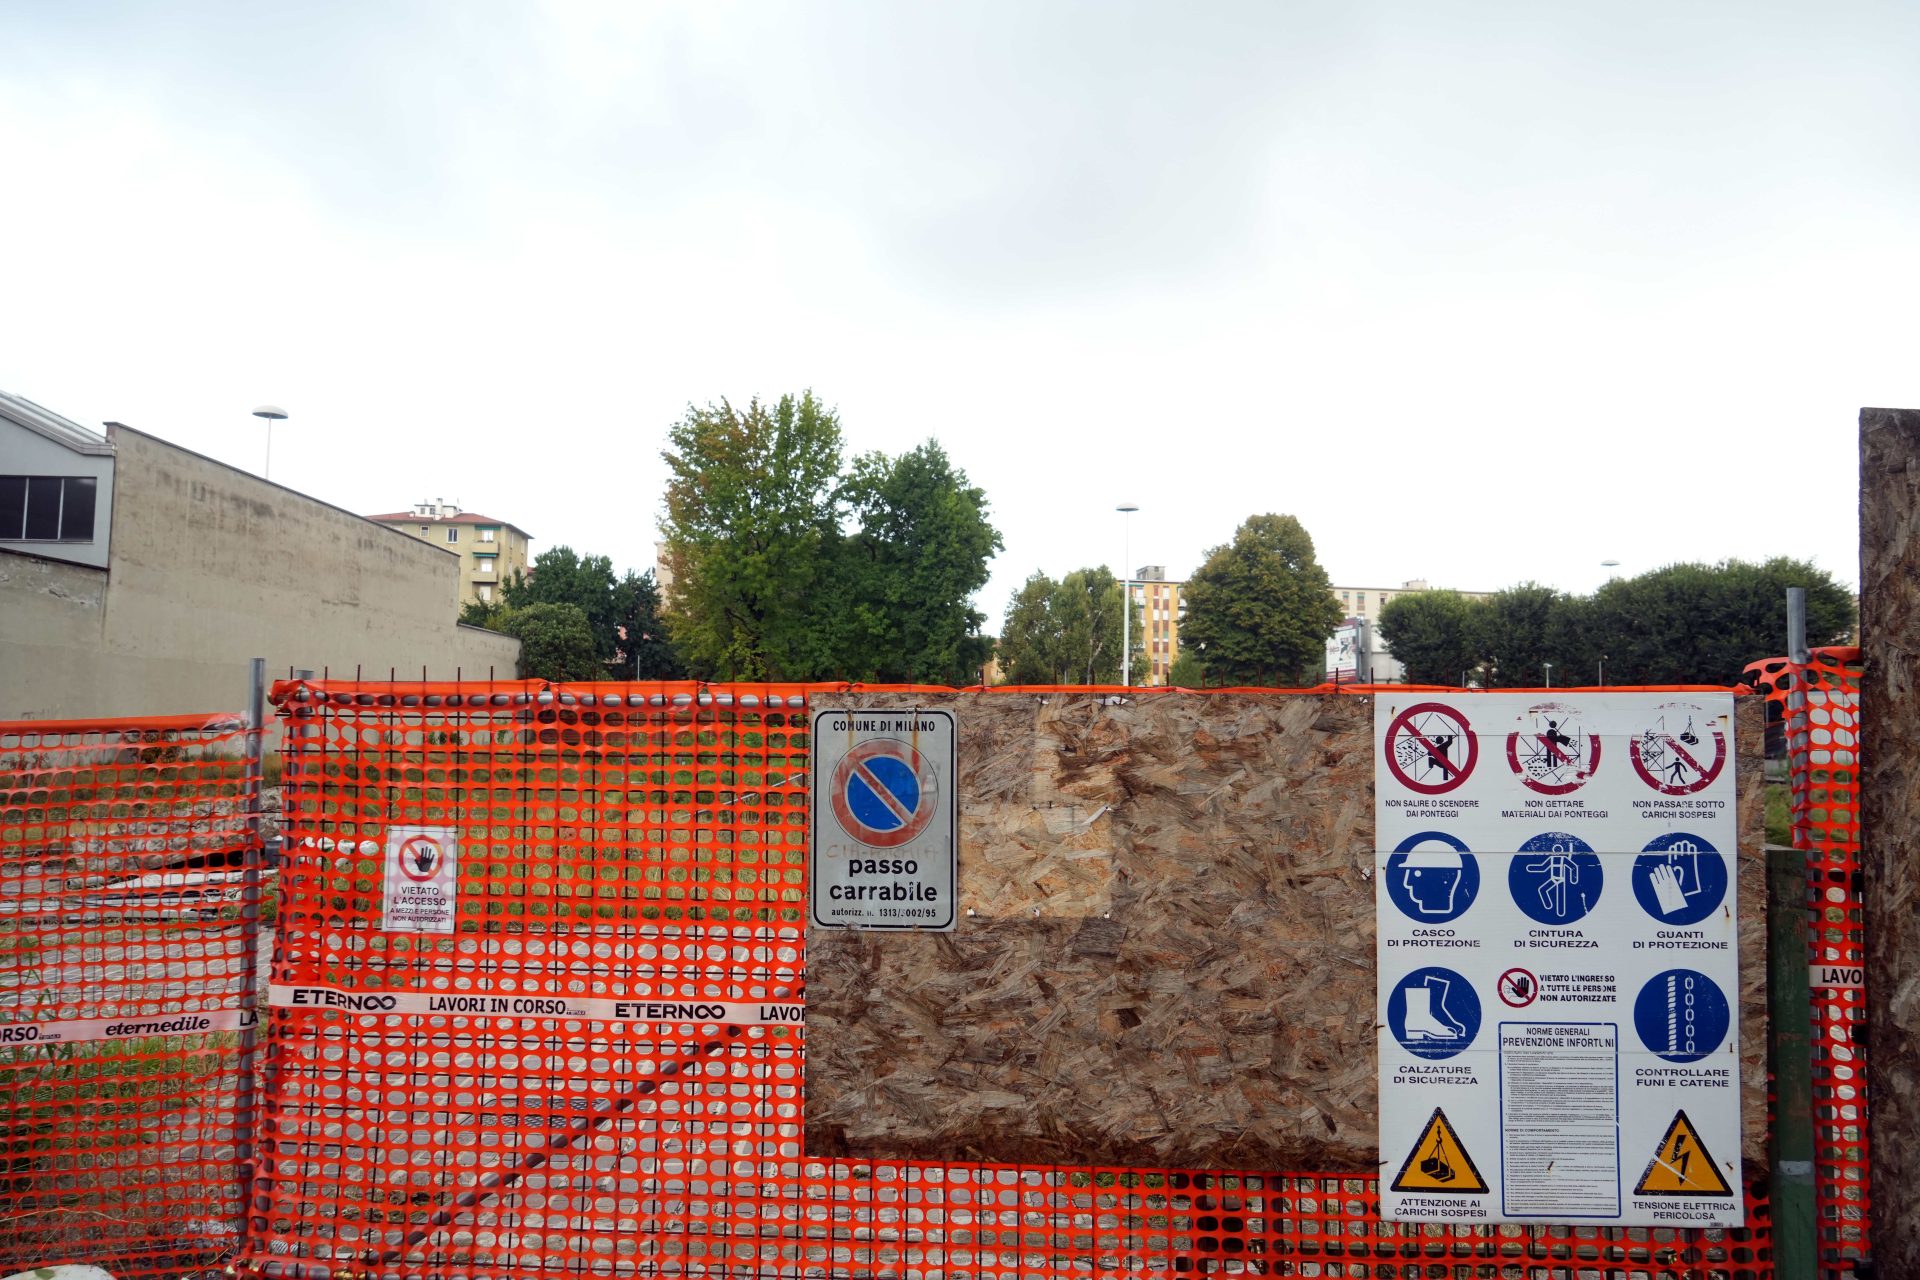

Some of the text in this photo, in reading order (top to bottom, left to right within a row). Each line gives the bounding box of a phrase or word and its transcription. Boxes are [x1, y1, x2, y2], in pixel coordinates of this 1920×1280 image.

[832, 720, 936, 732] COMUNE DI MILANO
[1402, 800, 1430, 808] SALIRE
[1431, 800, 1438, 808] O
[1438, 800, 1480, 808] SCENDERE
[1632, 800, 1653, 808] NON
[1697, 801, 1725, 809] SOTTO
[1406, 810, 1460, 818] DAI PONTEGGI
[1564, 811, 1609, 819] PONTEGGI
[1641, 811, 1716, 819] CARICHI SOSPESI
[849, 860, 917, 877] passo
[401, 887, 440, 896] VIETATO
[830, 882, 937, 901] carrabile
[393, 897, 447, 906] L'ACCESSO
[420, 908, 450, 916] PERSONE
[831, 908, 864, 917] autorizz.
[1528, 930, 1584, 938] CINTURA
[1656, 931, 1704, 939] GUANTI
[1403, 939, 1481, 948] PROTEZIONE
[1529, 940, 1599, 948] SICUREZZA
[1649, 941, 1729, 950] PROTEZIONE
[1582, 985, 1617, 993] PERSONE
[1560, 995, 1617, 1003] AUTORIZZATE
[430, 997, 485, 1012] LAVORI
[491, 999, 508, 1012] IN
[514, 999, 568, 1014] CORSO
[106, 1017, 209, 1039] eternedile
[1526, 1028, 1590, 1036] NORME GENERALI
[1502, 1038, 1564, 1047] PREVENZIONE
[1399, 1066, 1472, 1075] CALZATURE
[1635, 1069, 1730, 1077] CONTROLLARE
[1408, 1077, 1479, 1085] SICUREZZA
[1636, 1079, 1665, 1087] FUNI
[1679, 1080, 1729, 1088] CATENE
[1400, 1199, 1481, 1208] ATTENZIONE AI
[1632, 1202, 1736, 1211] TENSIONE ELETTRICA
[1394, 1208, 1487, 1218] CARICHI SOSPESI
[1653, 1212, 1716, 1220] PERICOLOSA
